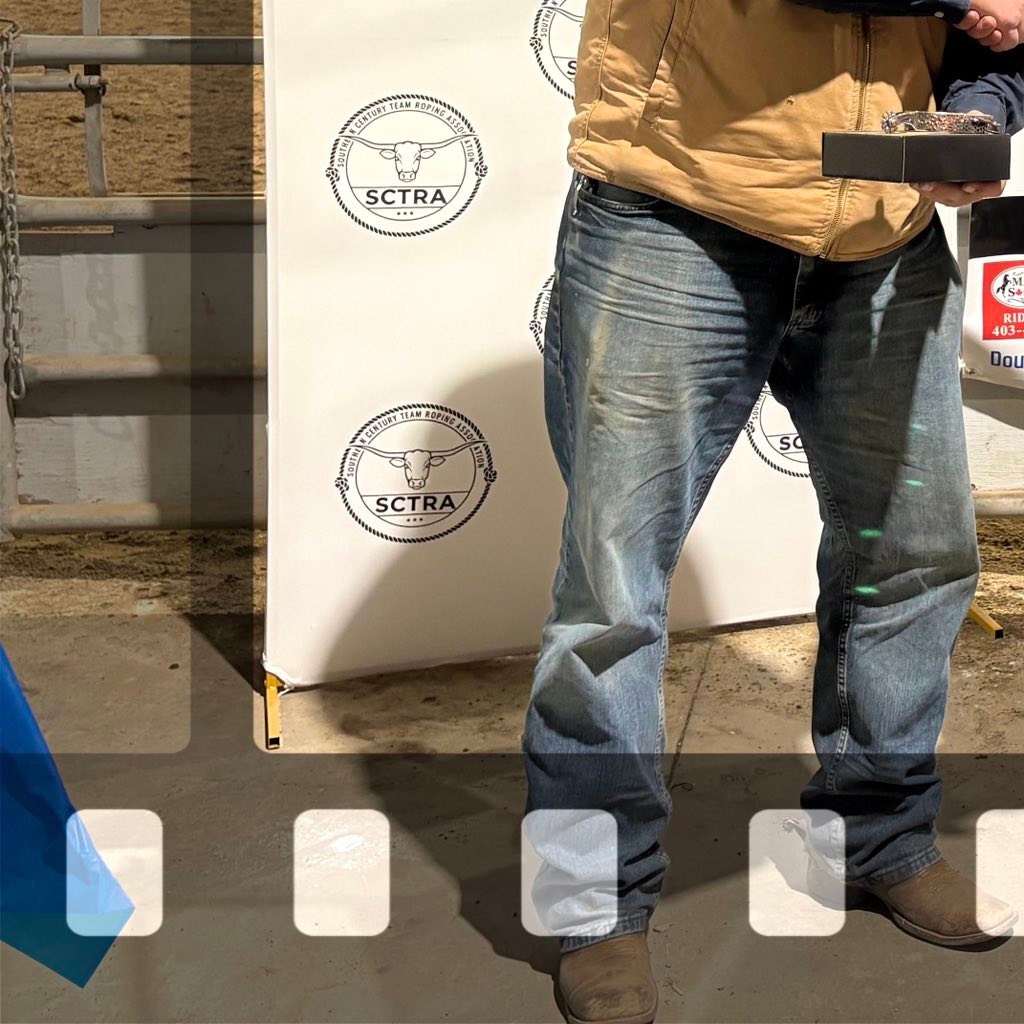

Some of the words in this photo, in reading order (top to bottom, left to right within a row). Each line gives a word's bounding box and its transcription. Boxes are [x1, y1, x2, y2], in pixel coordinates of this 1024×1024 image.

[540, 0, 559, 37] SOUTHEN
[337, 129, 357, 168] SOUTHEN
[354, 105, 386, 129] CENTURY
[389, 102, 411, 110] TEAM
[414, 101, 445, 117] ROPING
[446, 116, 475, 163] ASSOATION
[365, 188, 447, 205] SCTRA
[347, 437, 366, 477] SOUTHEN
[365, 414, 397, 438] CENTURY
[400, 410, 422, 420] TEAM
[425, 410, 456, 425] ROPING
[456, 423, 485, 469] ASSOATION
[375, 494, 456, 513] SCTRA
